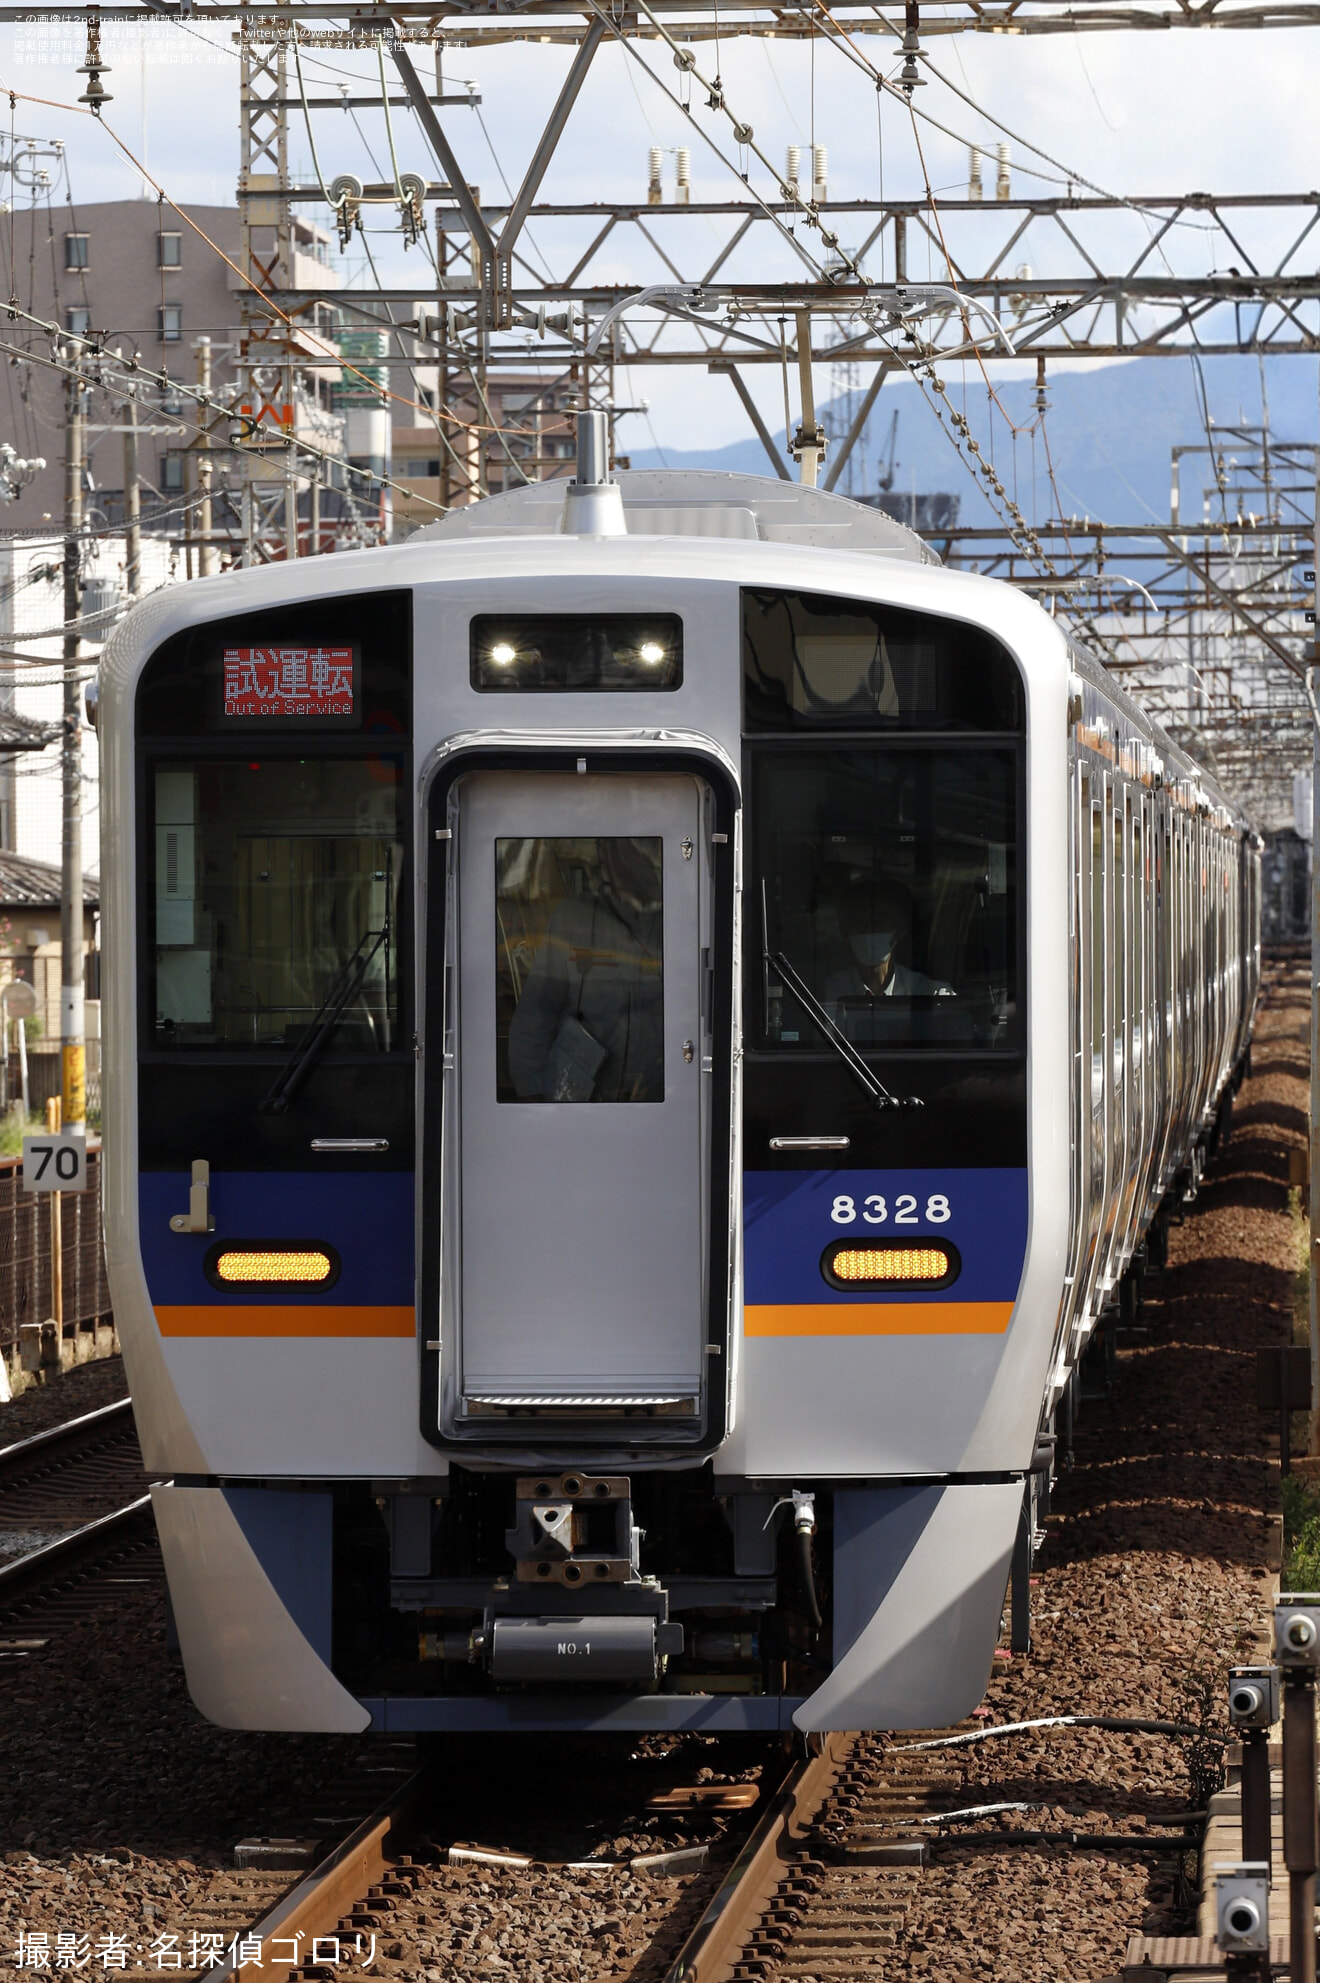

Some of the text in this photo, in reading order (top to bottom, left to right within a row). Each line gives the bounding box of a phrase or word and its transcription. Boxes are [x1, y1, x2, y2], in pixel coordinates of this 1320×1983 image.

[224, 648, 353, 698] 試運転
[225, 699, 351, 715] Out of Service
[30, 1146, 79, 1181] 70
[830, 1194, 952, 1224] 8328
[557, 1642, 591, 1655] NO.1
